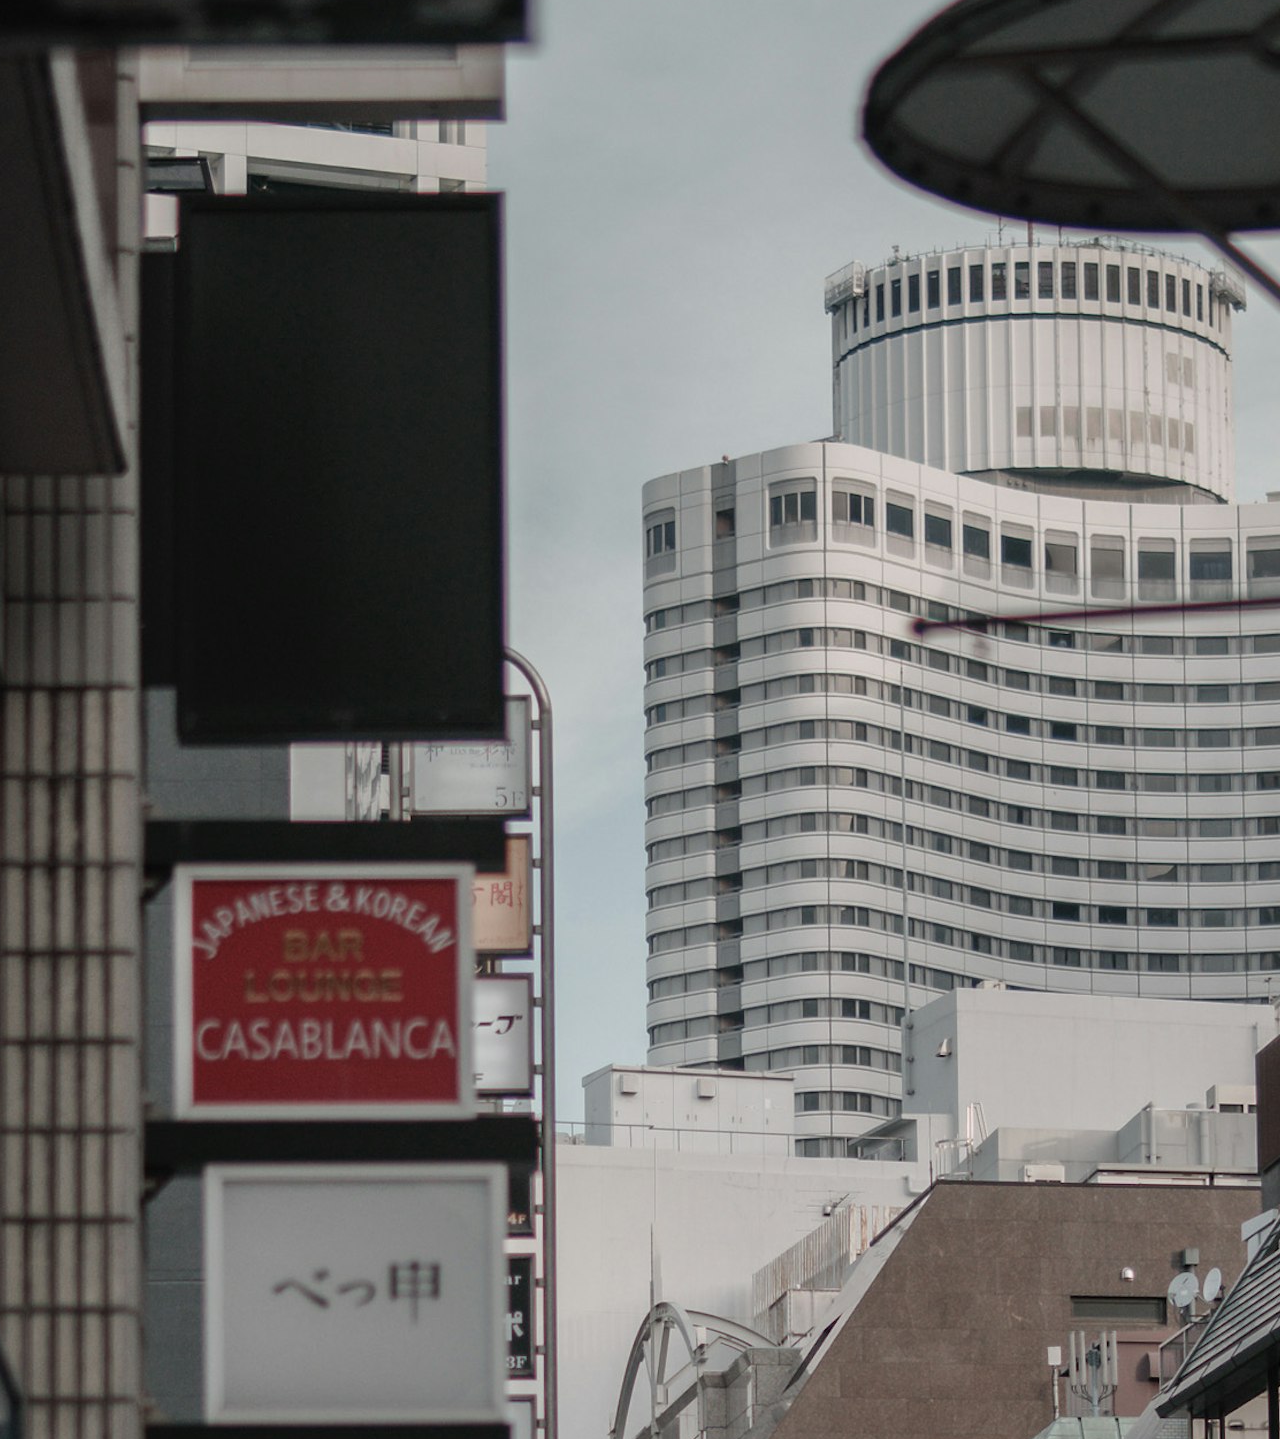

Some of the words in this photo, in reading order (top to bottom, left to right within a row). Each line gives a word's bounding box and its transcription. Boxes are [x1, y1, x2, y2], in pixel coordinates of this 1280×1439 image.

[495, 786, 523, 808] 5F
[194, 882, 321, 960] JAPANESE
[325, 882, 350, 912] &
[354, 886, 455, 954] KOREAN
[282, 928, 364, 962] BAR
[243, 968, 404, 1003] LOUNGE
[195, 1017, 456, 1061] CASABLANCA
[507, 1213, 528, 1226] 4F
